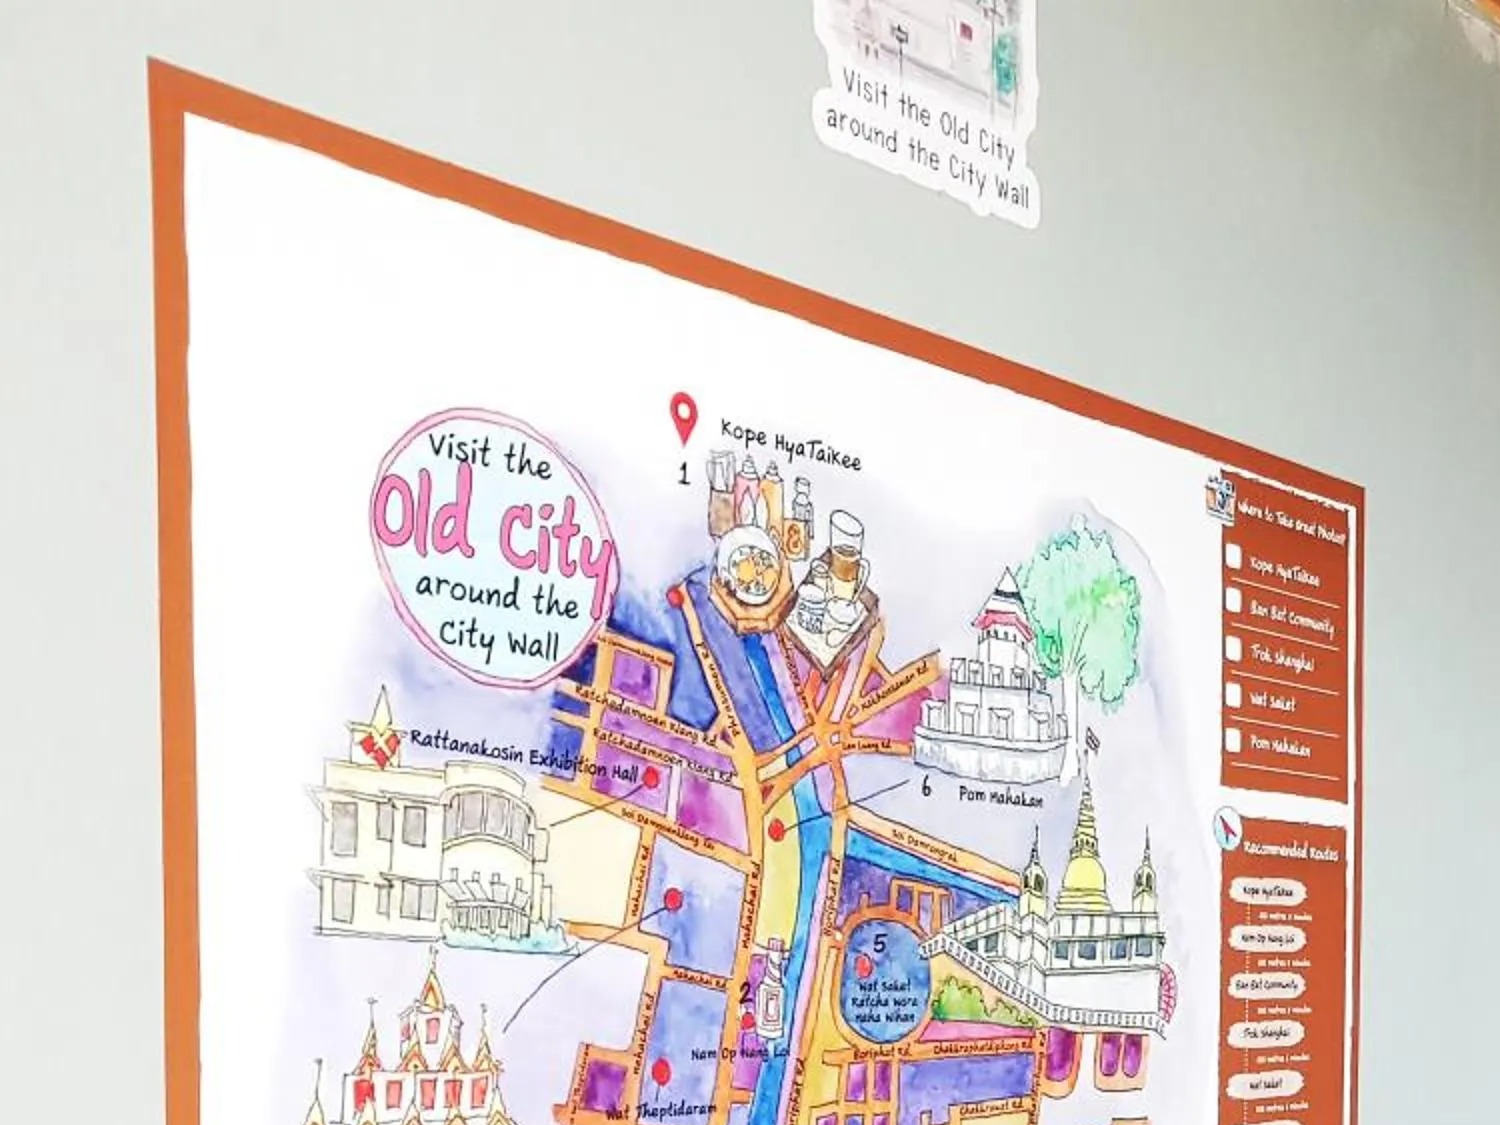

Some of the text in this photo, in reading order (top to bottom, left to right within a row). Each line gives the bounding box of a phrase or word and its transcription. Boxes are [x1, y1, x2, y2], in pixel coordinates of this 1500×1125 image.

[843, 66, 1015, 170] Visit the Old City
[826, 108, 1029, 209] around the City Wall
[428, 433, 553, 480] Visit the
[720, 418, 864, 472] Kope HyaTaikee
[678, 461, 692, 486] 1
[374, 461, 474, 558] Old
[416, 575, 580, 620] around the
[1250, 599, 1335, 640] Ban Bat Community
[439, 621, 559, 664] City Wall
[410, 729, 638, 783] Rattanakosin Exhibition Hall
[703, 731, 718, 747] Rd
[922, 775, 932, 797] 6
[959, 786, 986, 802] Pom
[873, 933, 889, 953] 5
[738, 981, 753, 1005] 2
[692, 1048, 717, 1061] Nam
